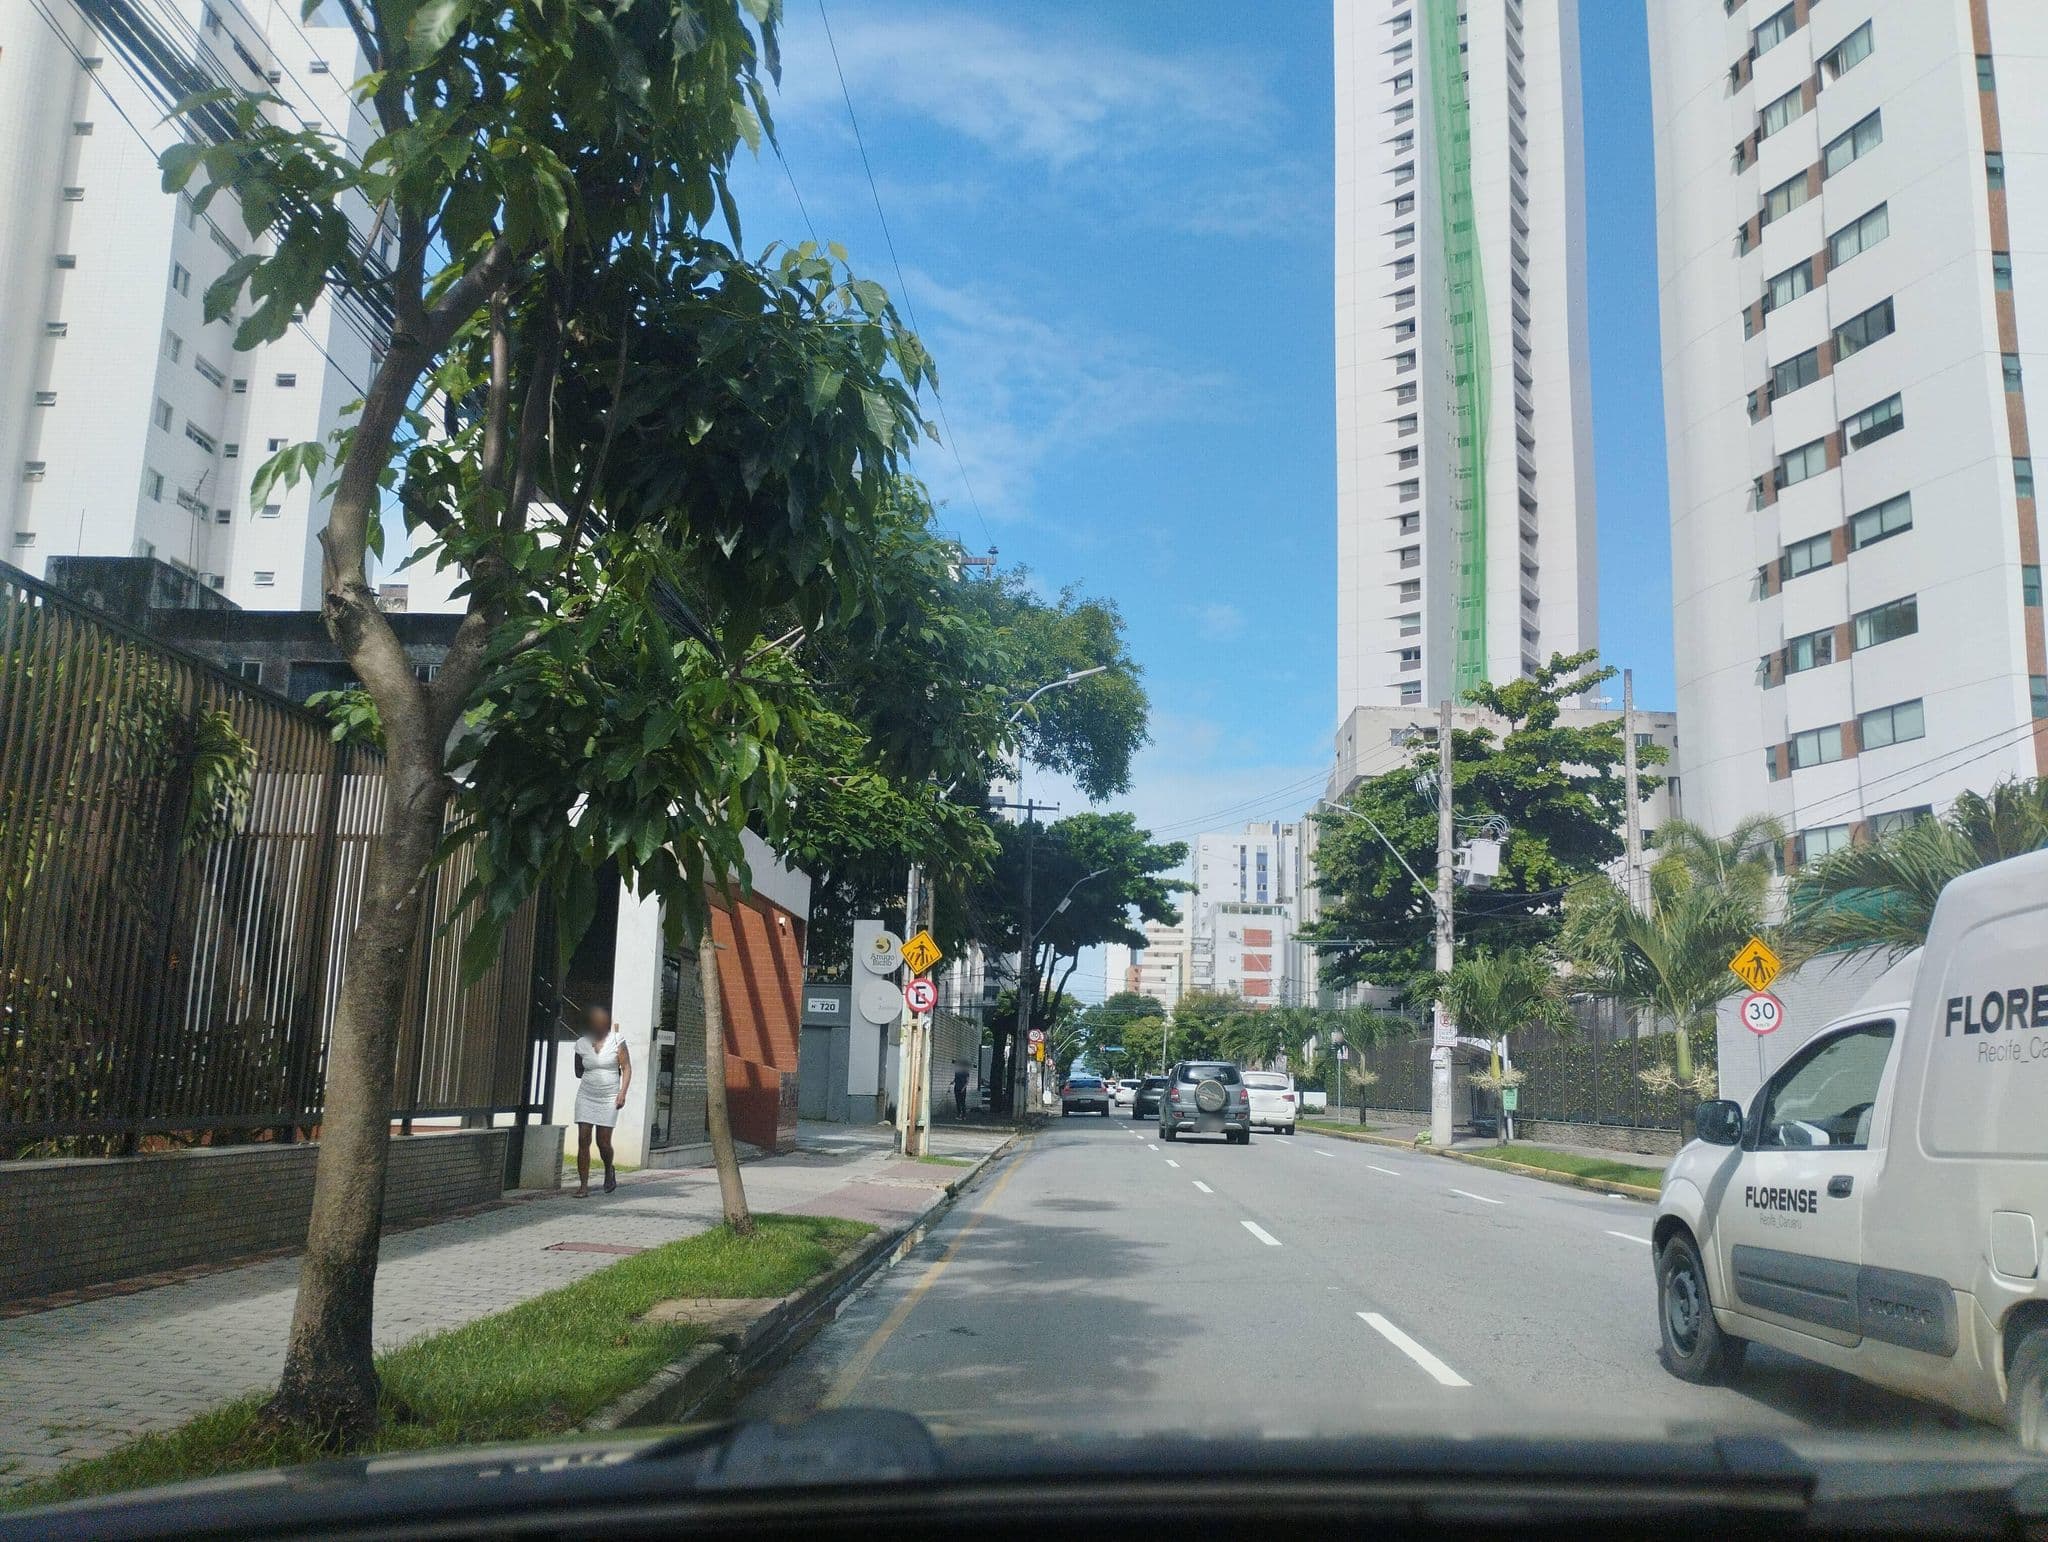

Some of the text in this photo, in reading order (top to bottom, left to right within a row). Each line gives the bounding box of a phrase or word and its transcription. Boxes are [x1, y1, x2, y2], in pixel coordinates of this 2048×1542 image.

[916, 986, 927, 1004] E
[820, 1003, 836, 1011] 720
[1750, 1002, 1775, 1020] 30
[1945, 984, 2048, 1037] FLORE
[1745, 1186, 1818, 1214] FLORENSE
